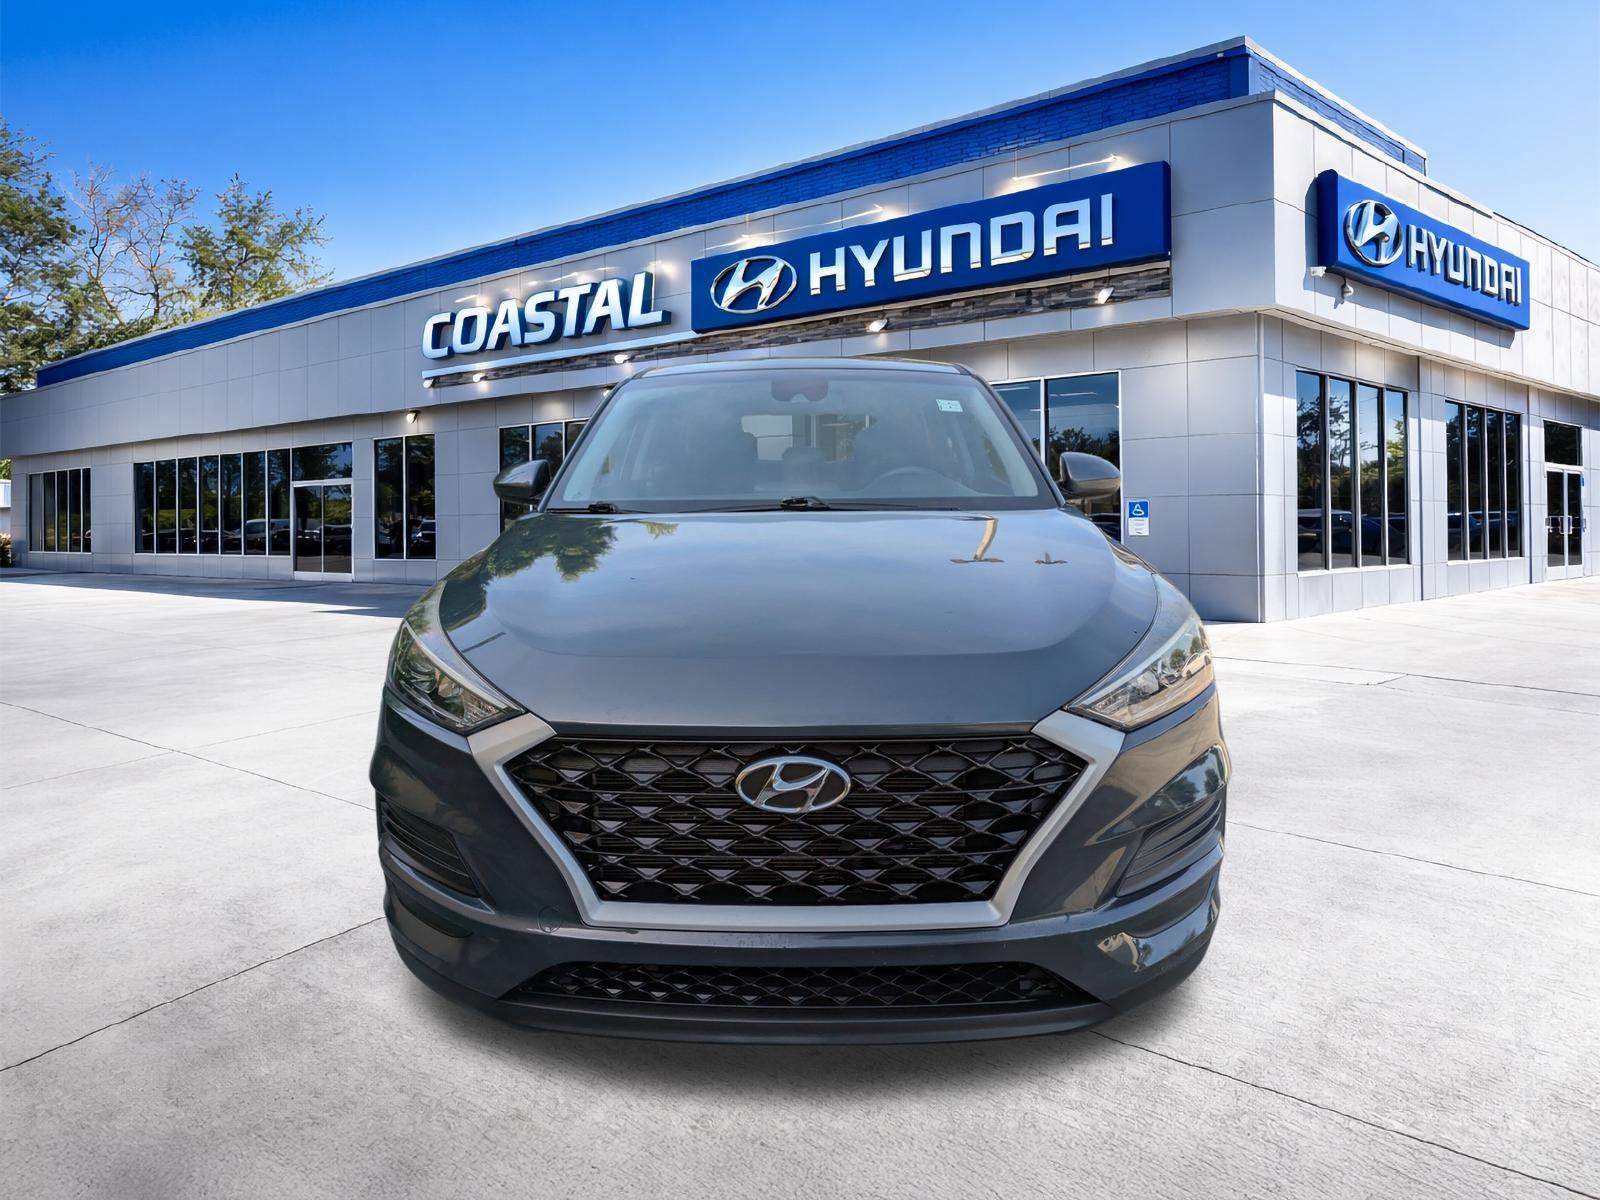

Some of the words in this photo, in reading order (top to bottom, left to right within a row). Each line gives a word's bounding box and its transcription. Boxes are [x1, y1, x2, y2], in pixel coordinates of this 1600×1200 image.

[809, 193, 1114, 296] HYUNDAI
[1407, 224, 1523, 306] HYUNDAI
[421, 271, 667, 360] COASTAL
